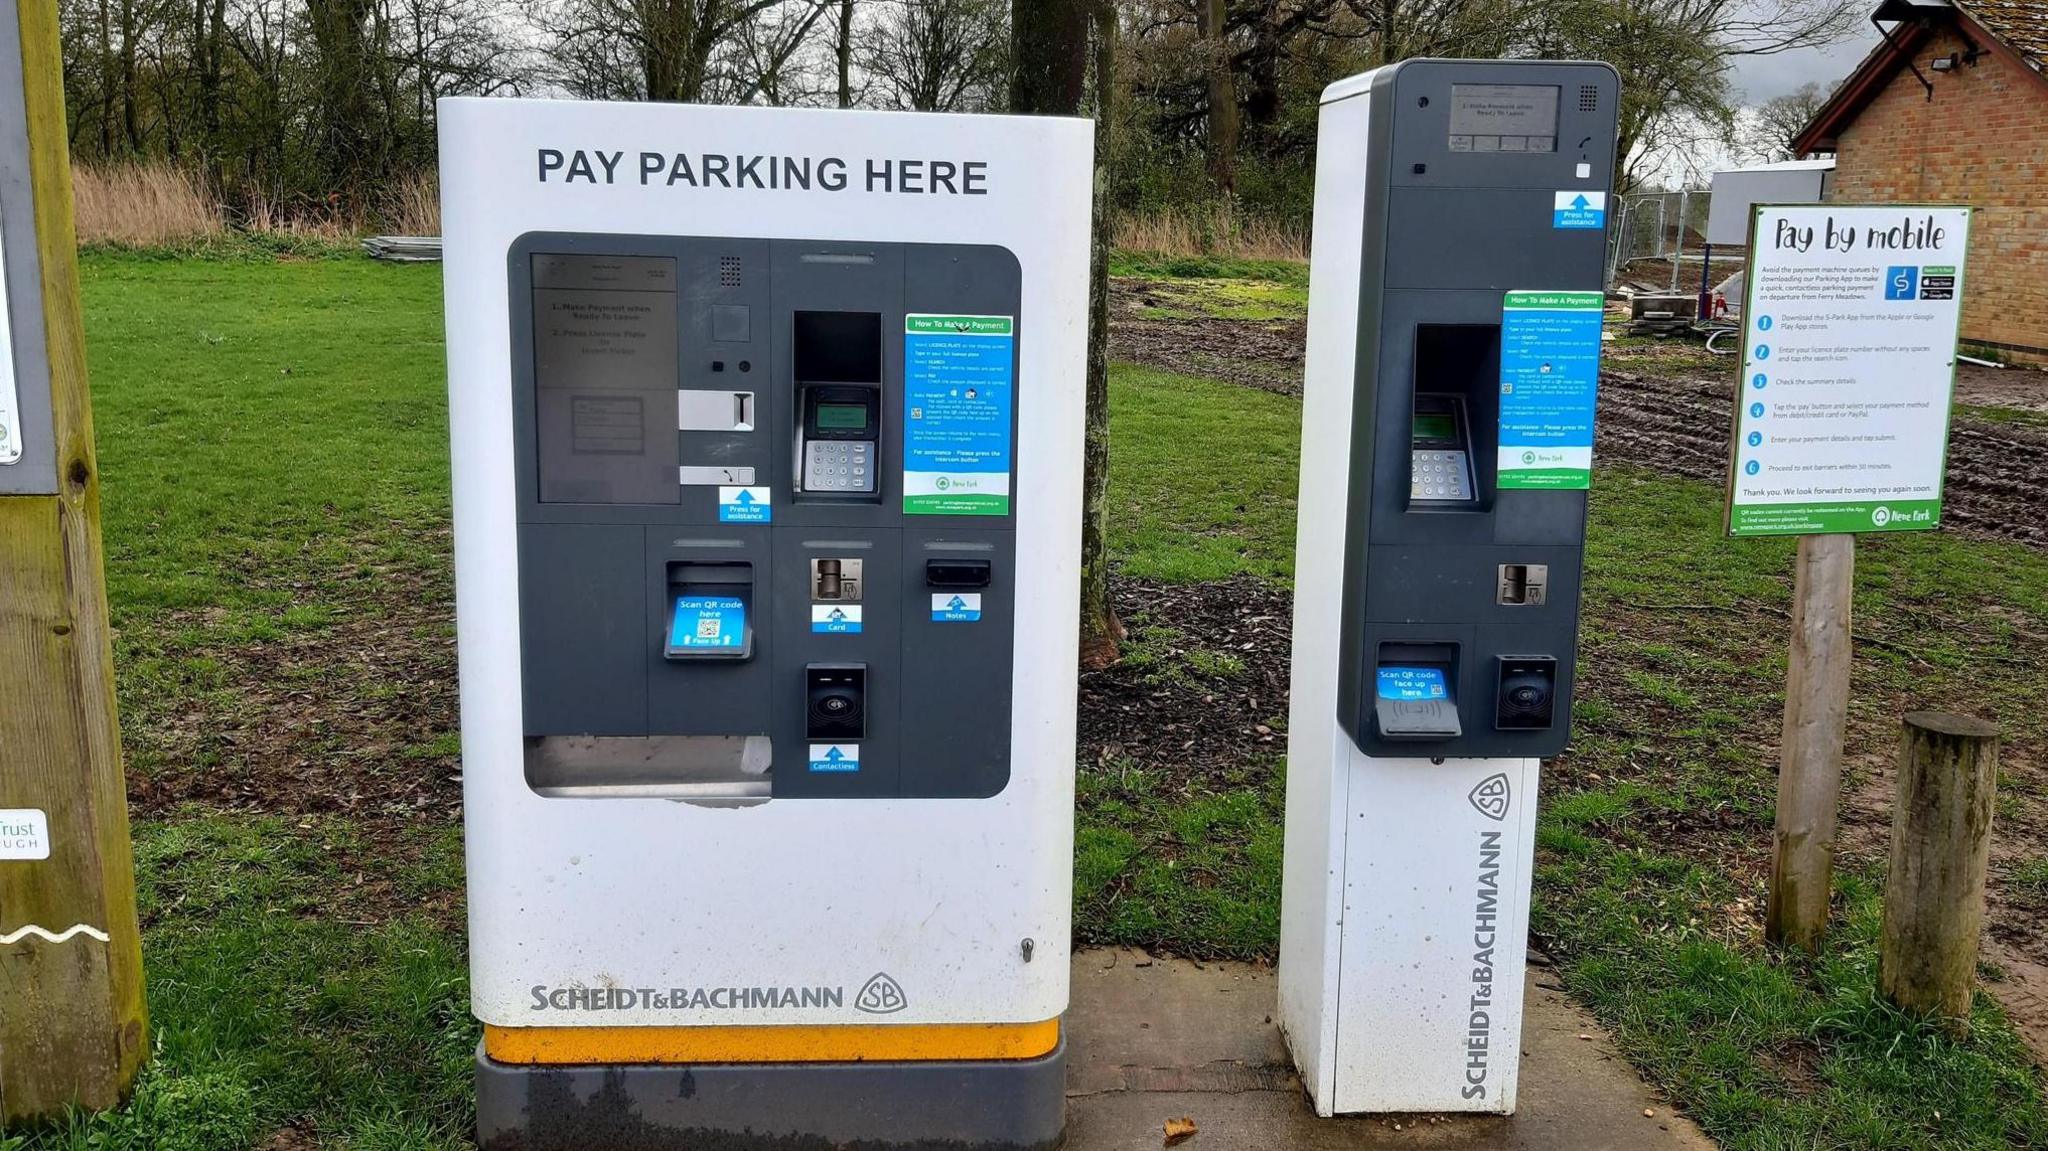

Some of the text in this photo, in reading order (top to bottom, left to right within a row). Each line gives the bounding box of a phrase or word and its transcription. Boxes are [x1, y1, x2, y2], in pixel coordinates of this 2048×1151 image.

[538, 149, 988, 195] PAY PARKING HERE
[1776, 215, 1946, 254] Pay by mobile
[1792, 267, 1820, 276] payment
[1848, 268, 1870, 276] queues
[1872, 266, 1880, 275] by
[1566, 298, 1598, 306] Payment
[914, 320, 932, 328] How
[972, 321, 1004, 331] Payment
[1760, 347, 1766, 358] 2
[1758, 376, 1763, 387] 3
[1755, 405, 1760, 416] 4
[1752, 433, 1759, 444] 5
[1749, 462, 1755, 472] 6
[1766, 489, 1782, 498] you.
[1854, 486, 1876, 495] seeing
[1878, 487, 1891, 495] you
[1892, 486, 1912, 494] again
[680, 600, 742, 609] Scan QR code
[700, 610, 721, 618] here
[828, 623, 846, 631] Card
[1380, 670, 1436, 679] Scan QR code
[1414, 681, 1426, 689] up
[0, 821, 35, 836] rust
[1462, 831, 1502, 1100] SCHEIDT&BACHMANN
[530, 985, 843, 1011] SCHEIDT&BACHMANN
